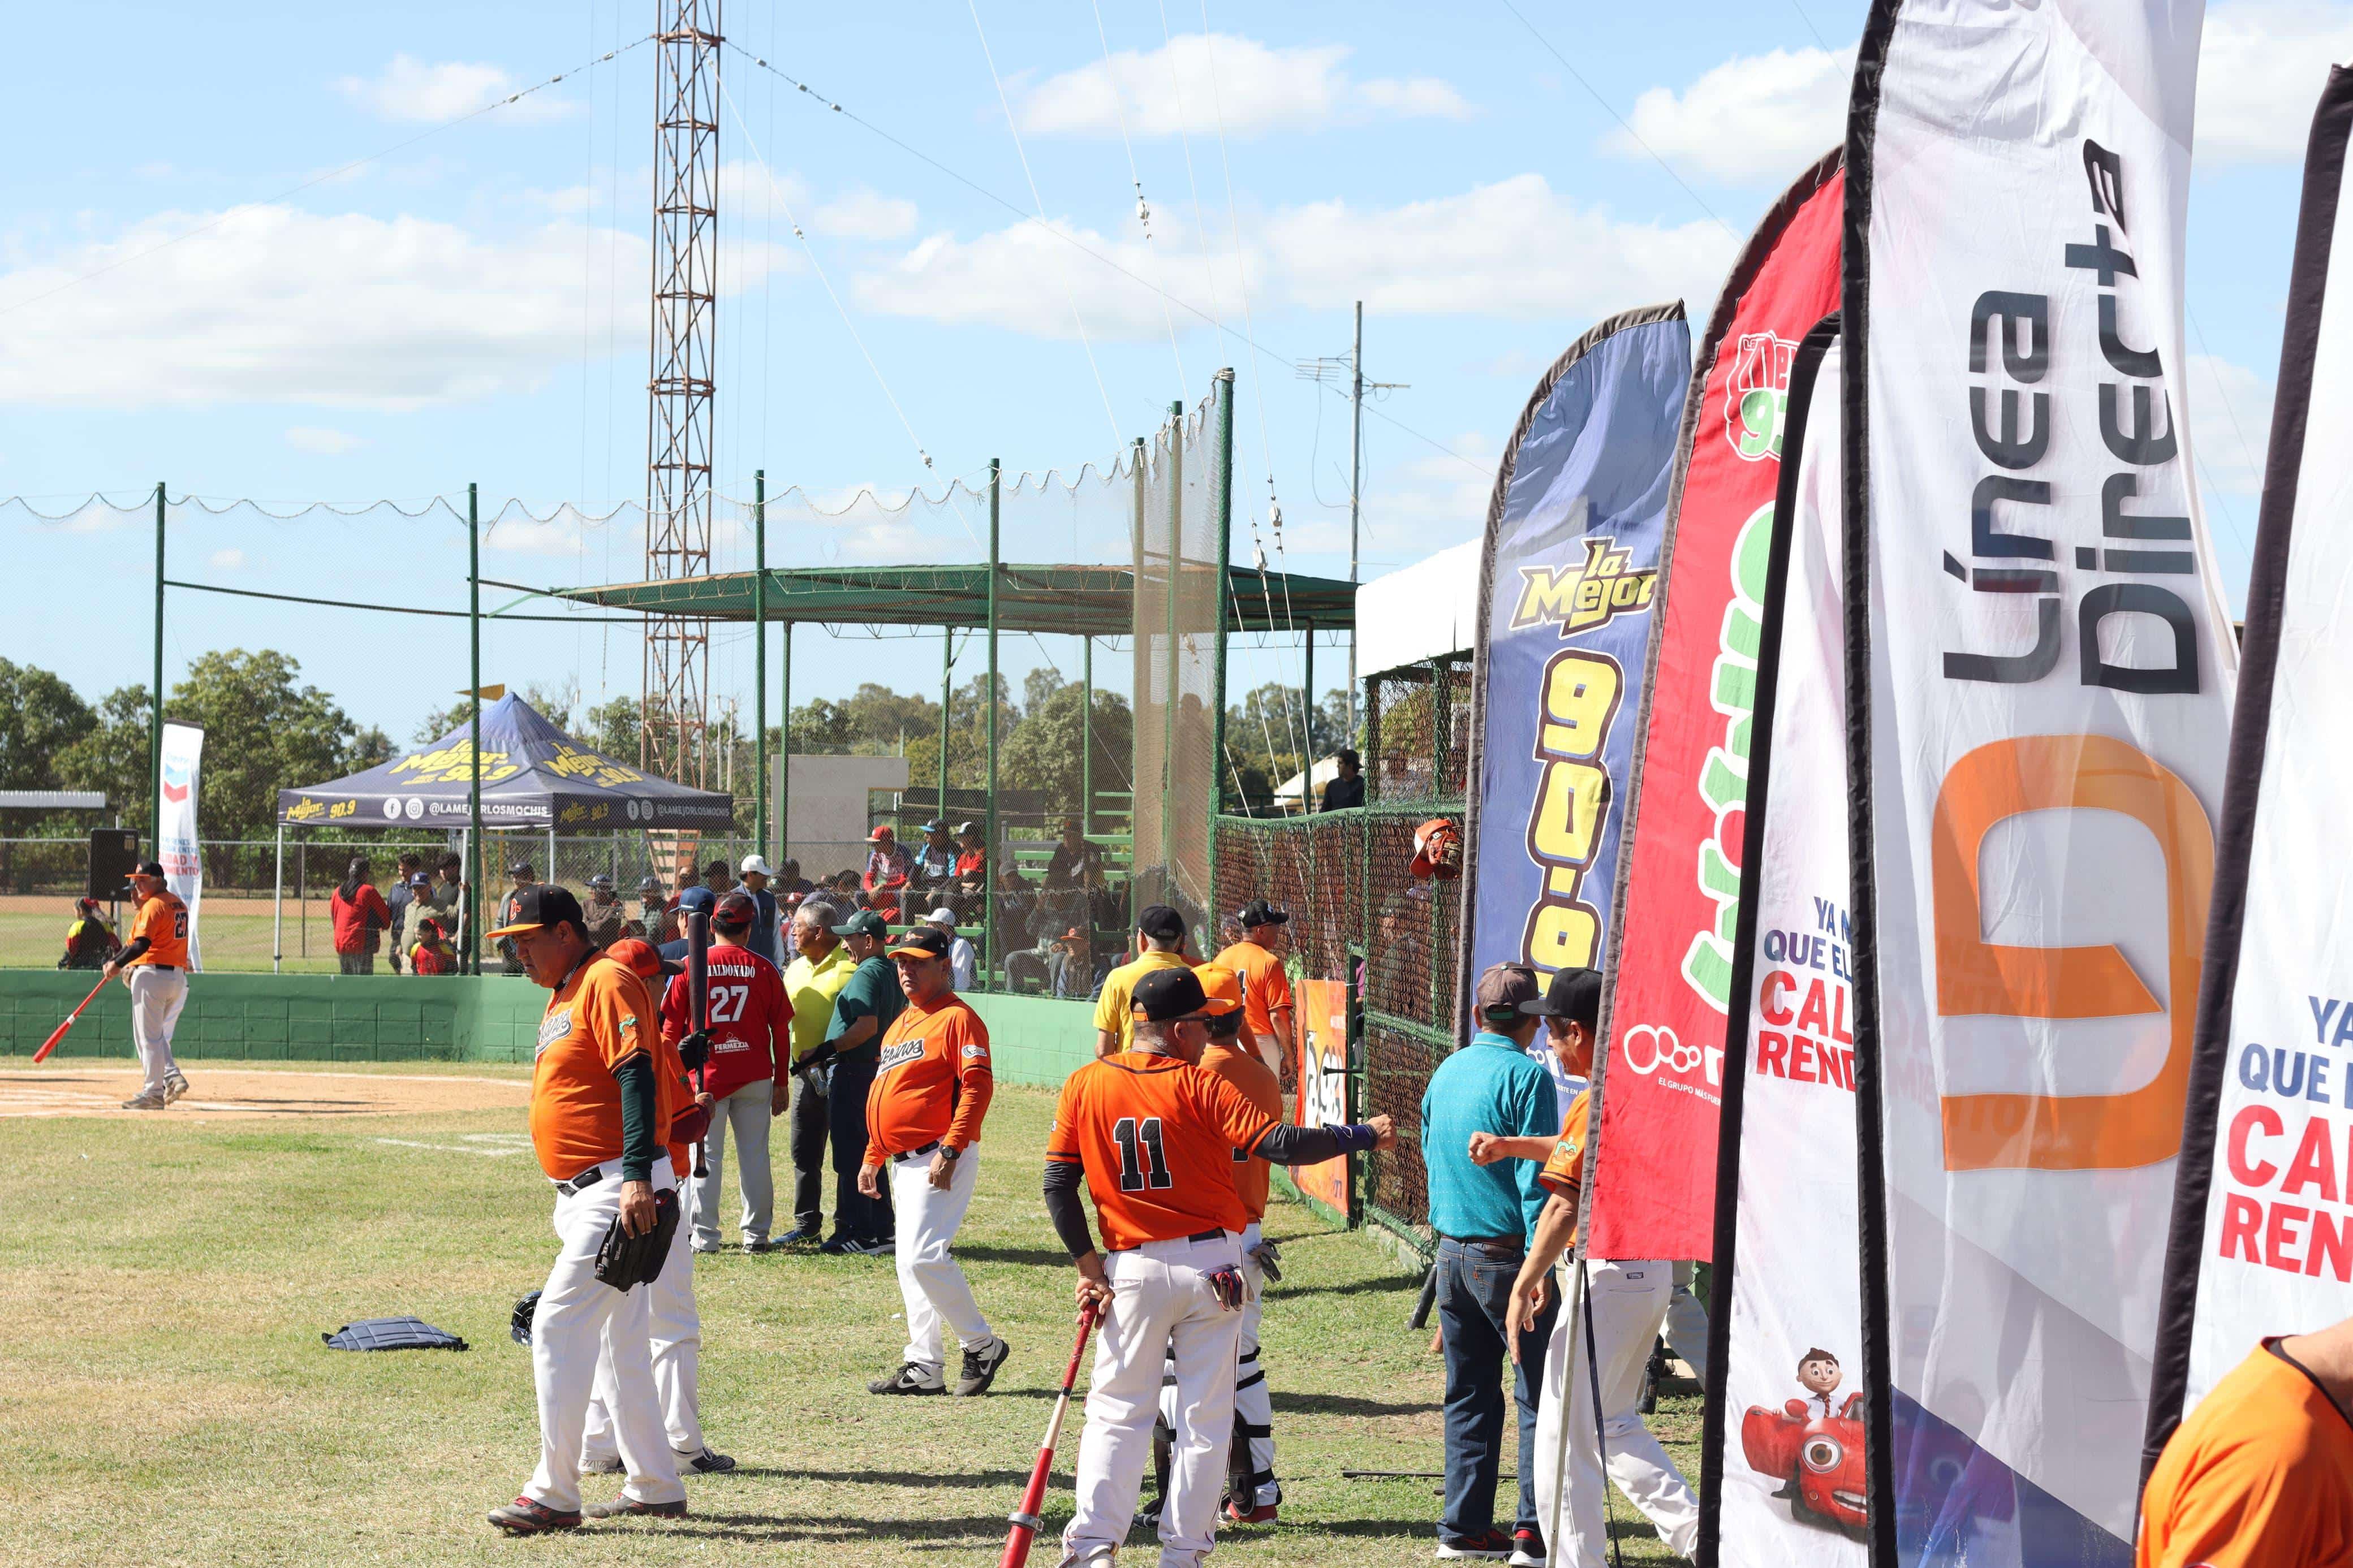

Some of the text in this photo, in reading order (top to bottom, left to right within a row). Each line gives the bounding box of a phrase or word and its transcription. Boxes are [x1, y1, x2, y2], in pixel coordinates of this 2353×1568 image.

[1943, 290, 2061, 684] Línea
[1584, 544, 1624, 579] la
[1519, 570, 1657, 629] Mejor
[330, 799, 356, 819] 90.9
[429, 802, 548, 815] @LAMEJRLOSMOCHIS
[1813, 896, 1835, 936] YA
[1764, 929, 1826, 971] QUE
[710, 985, 749, 1023] 27
[1658, 1077, 1666, 1086] EL
[1667, 1081, 1693, 1094] GRUPO
[2238, 1043, 2330, 1104] QUE
[1113, 1117, 1172, 1192] 11
